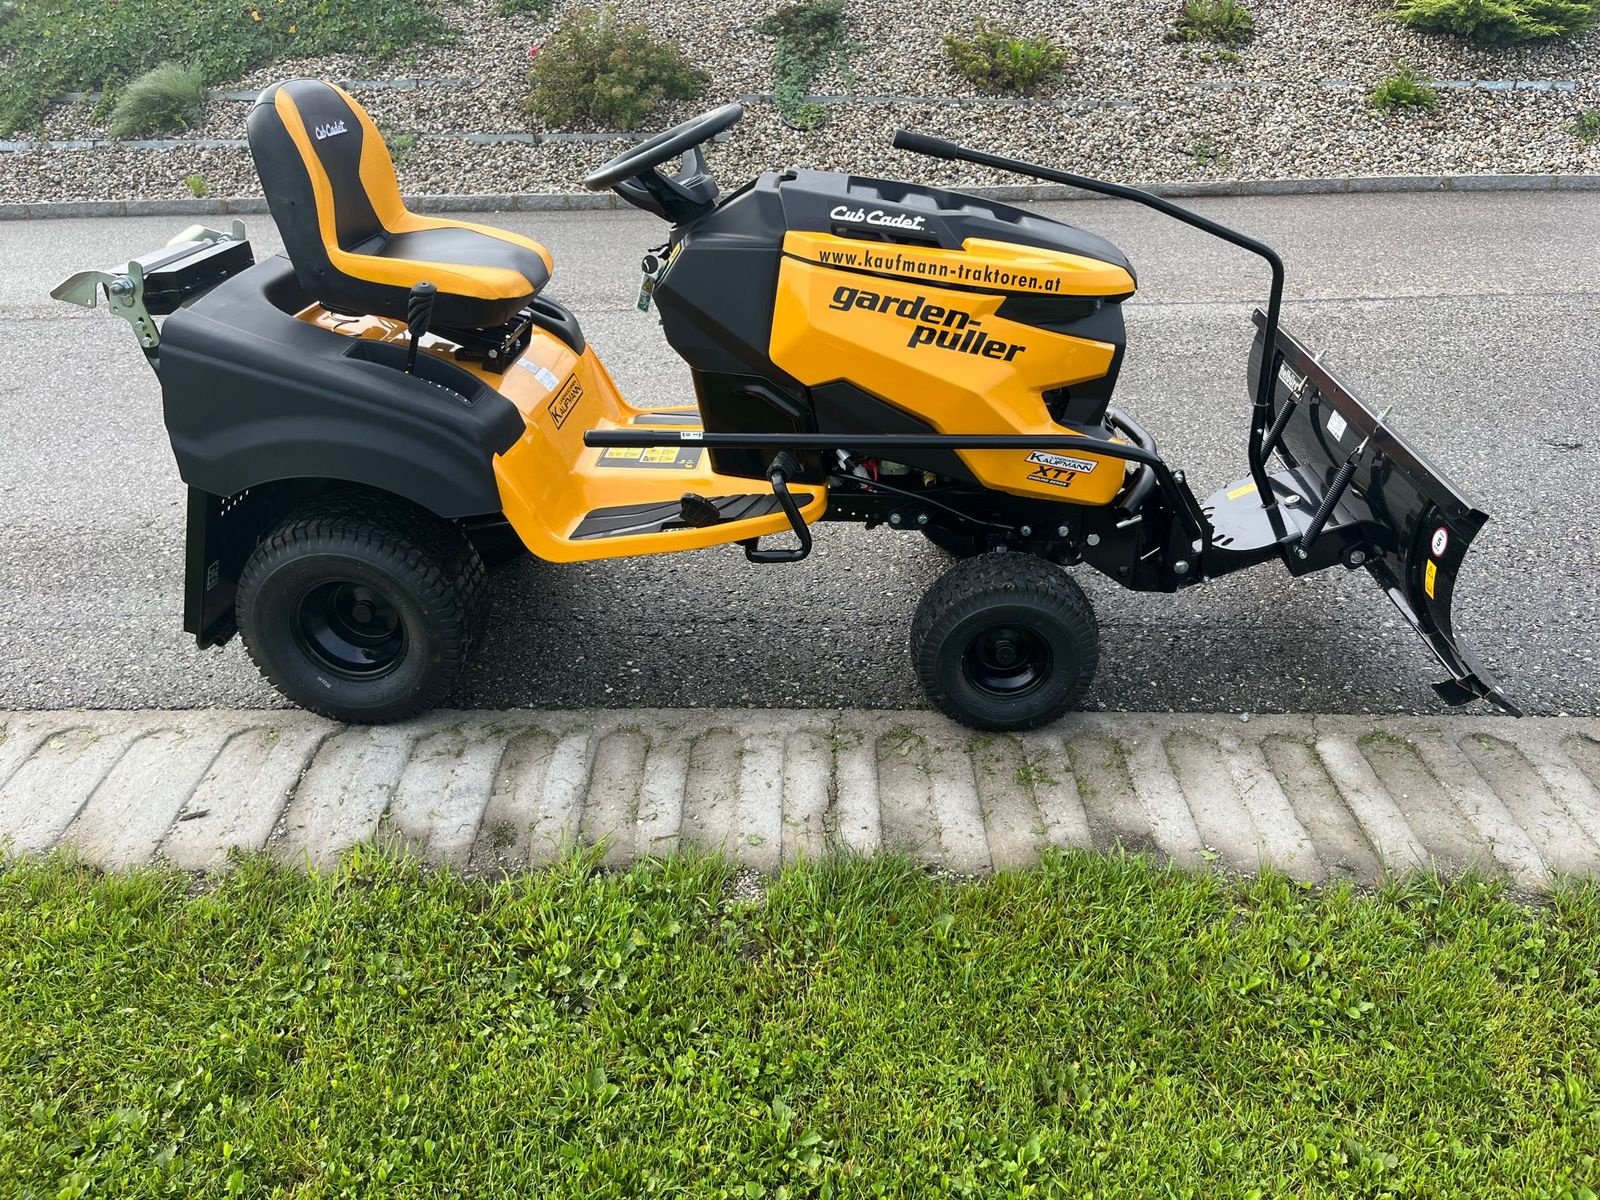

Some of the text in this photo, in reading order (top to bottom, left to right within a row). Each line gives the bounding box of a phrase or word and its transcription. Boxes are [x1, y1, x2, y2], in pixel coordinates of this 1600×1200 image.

[830, 206, 925, 231] Cub Cadet
[819, 250, 1061, 292] www.kaufmann-traktoren.at
[829, 286, 981, 330] garden-
[907, 325, 1026, 362] puller
[1032, 465, 1077, 482] XT1
